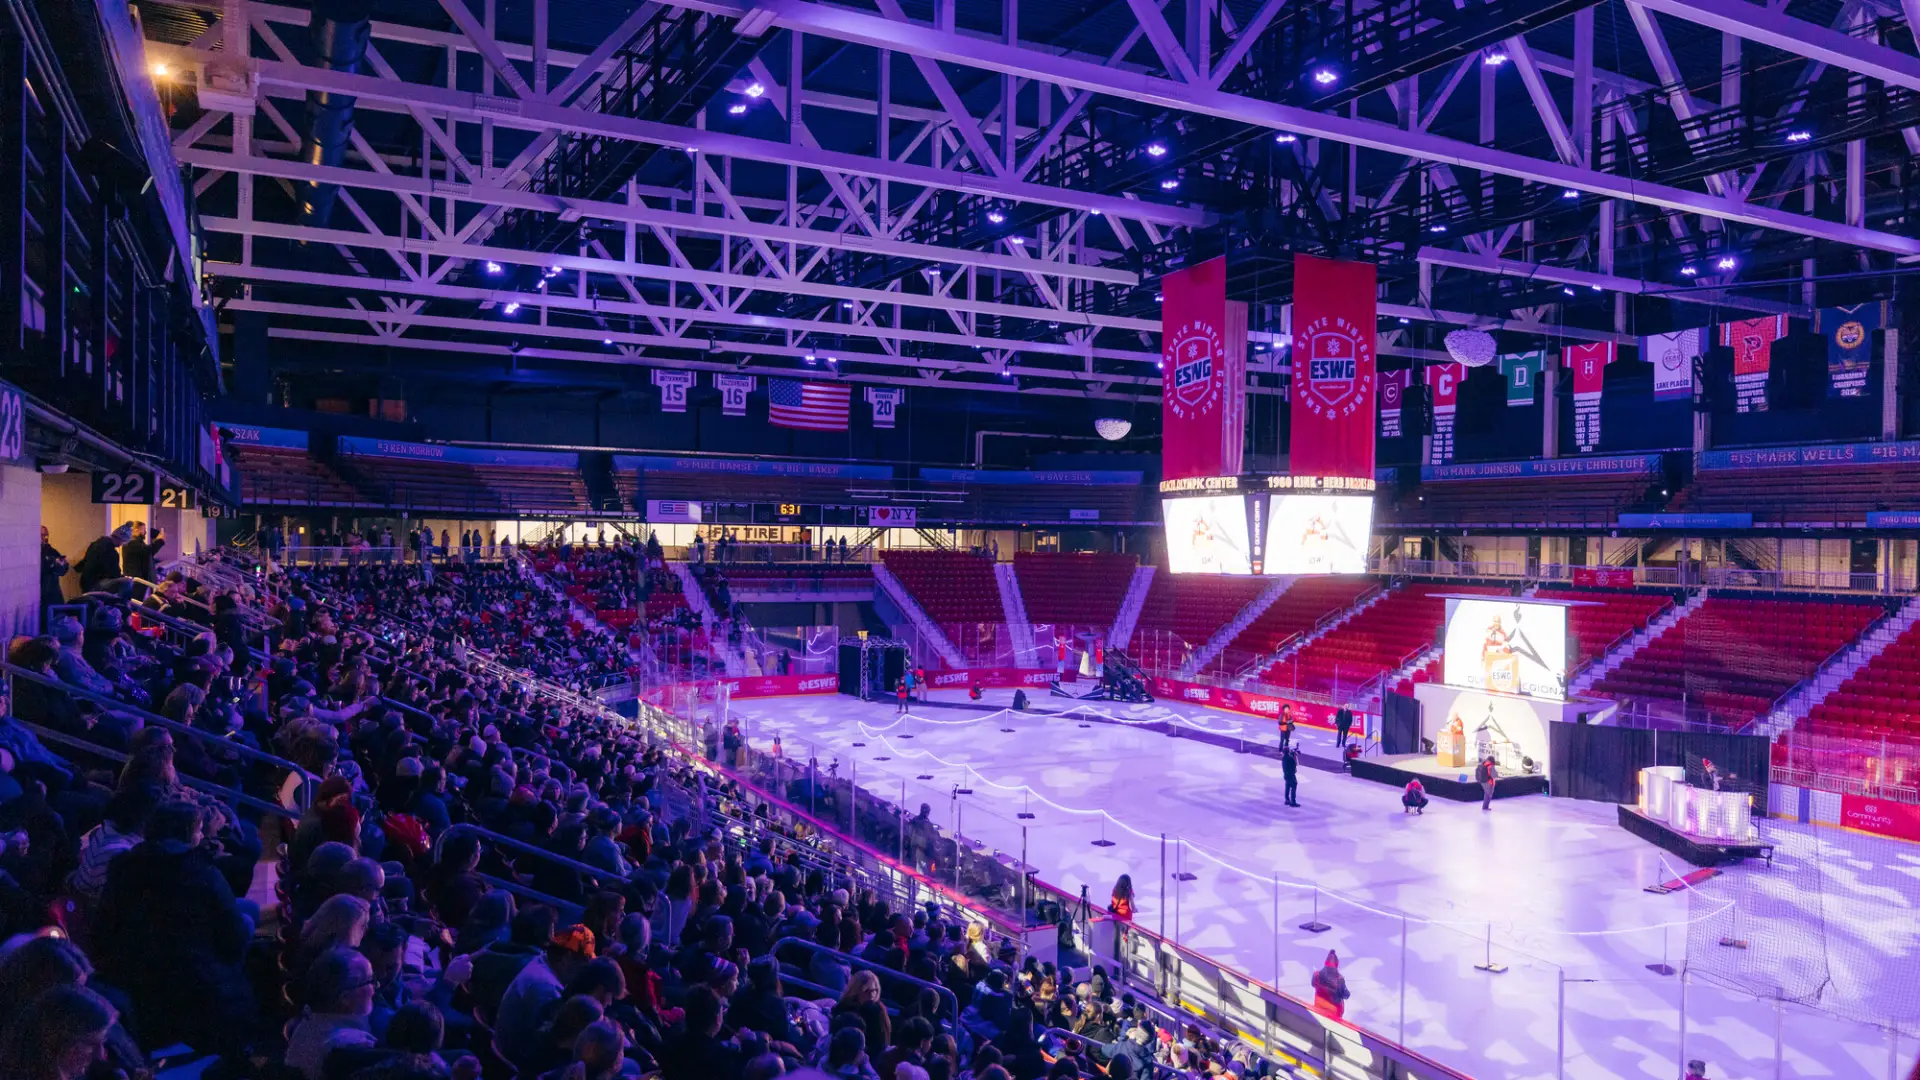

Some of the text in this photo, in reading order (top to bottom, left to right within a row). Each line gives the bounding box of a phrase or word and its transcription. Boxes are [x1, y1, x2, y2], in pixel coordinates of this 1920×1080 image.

[1297, 316, 1328, 350] STATE
[1742, 334, 1763, 362] P
[1176, 359, 1211, 389] ESWG
[1310, 360, 1356, 379] ESWG
[1584, 360, 1594, 374] H
[1514, 366, 1527, 387] D
[1438, 374, 1453, 397] C
[1656, 379, 1690, 390] LAKE PLACID
[665, 384, 683, 402] 15
[726, 387, 744, 405] 16
[1386, 386, 1396, 398] C
[876, 400, 892, 416] 20
[1, 390, 21, 460] 23
[230, 427, 260, 441] SZAK
[390, 443, 406, 454] KEN
[407, 443, 443, 457] MORROW
[1730, 447, 1854, 464] #15 MARK WELLS
[1871, 446, 1898, 458] #16
[692, 461, 716, 470] MIKE
[720, 462, 760, 472] RAMSEY
[808, 465, 839, 475] BAKER
[1450, 466, 1476, 476] MARK
[1479, 464, 1522, 475] JOHNSON
[1533, 457, 1646, 473] #11 STEVE CHRISTOFF
[1047, 474, 1069, 482] DAVE
[1071, 474, 1091, 482] SILK
[1205, 476, 1238, 489] CENTER
[1267, 476, 1292, 489] 1980
[1293, 476, 1317, 488] RINK
[1323, 476, 1344, 489] HERB
[102, 473, 145, 502] 22
[162, 488, 188, 509] 21
[206, 506, 220, 518] 19
[870, 507, 877, 520] I
[891, 508, 915, 520] NY
[713, 527, 779, 540] FAT TIRE
[943, 672, 968, 685] ESWG
[1033, 672, 1060, 683] ESWG
[1492, 671, 1512, 680] ESWG
[807, 676, 836, 690] ESWG
[1190, 687, 1210, 699] ESWG
[1257, 700, 1279, 713] ESWG
[1846, 809, 1893, 826] Community
